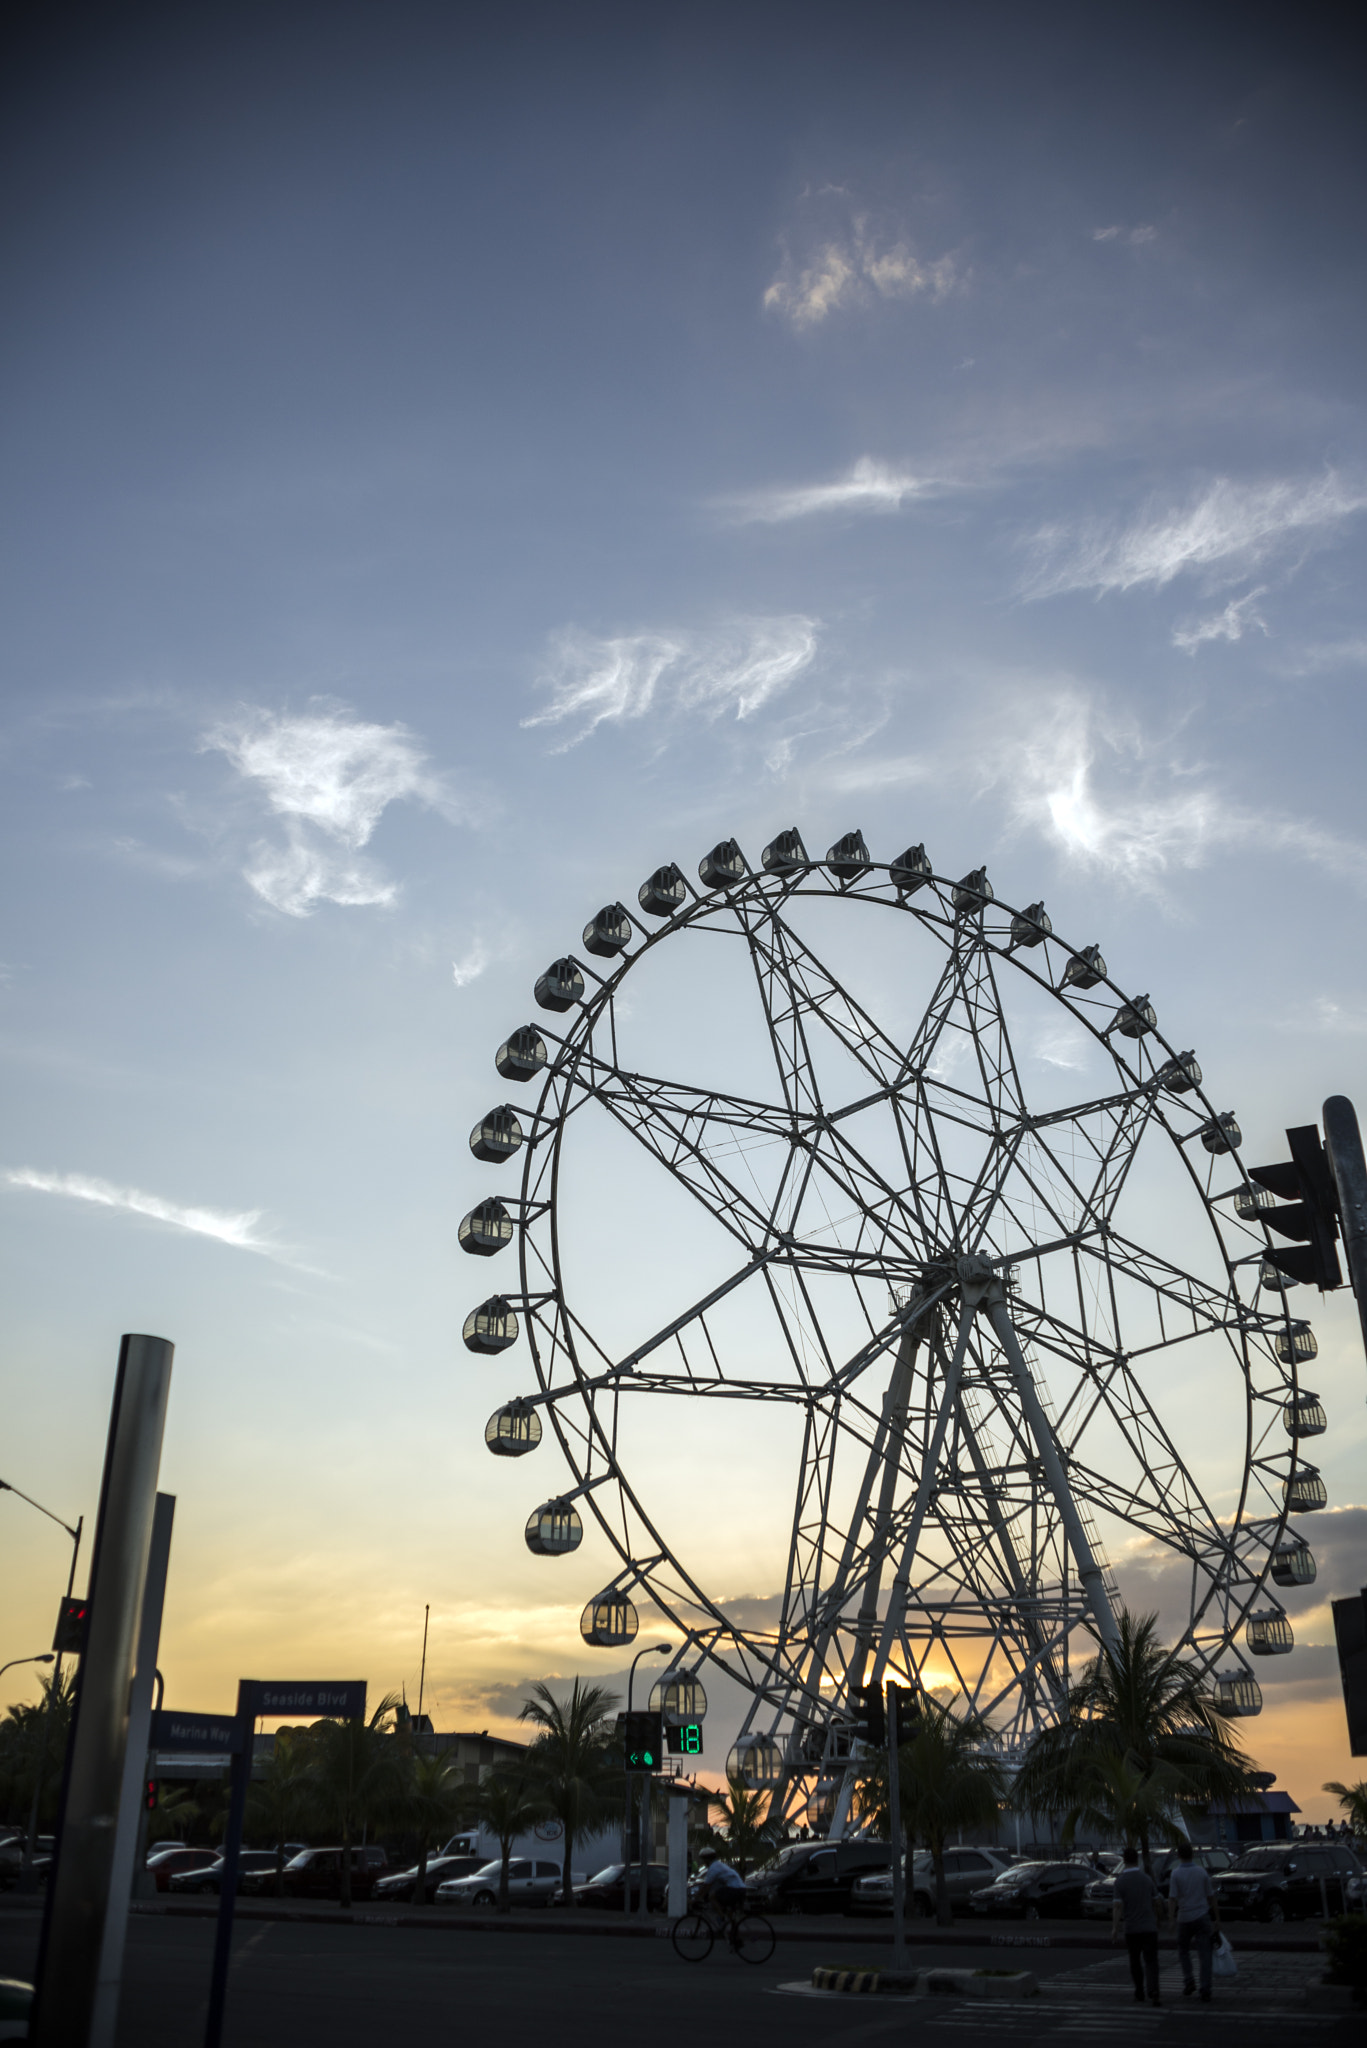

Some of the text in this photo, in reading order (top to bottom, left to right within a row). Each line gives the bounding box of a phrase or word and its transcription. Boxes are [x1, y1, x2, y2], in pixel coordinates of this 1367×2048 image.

[262, 1690, 347, 1706] Seaside Blvd
[170, 1723, 231, 1745] Marina Way
[680, 1724, 700, 1754] 18
[990, 1935, 1050, 1947] NO PARKING
